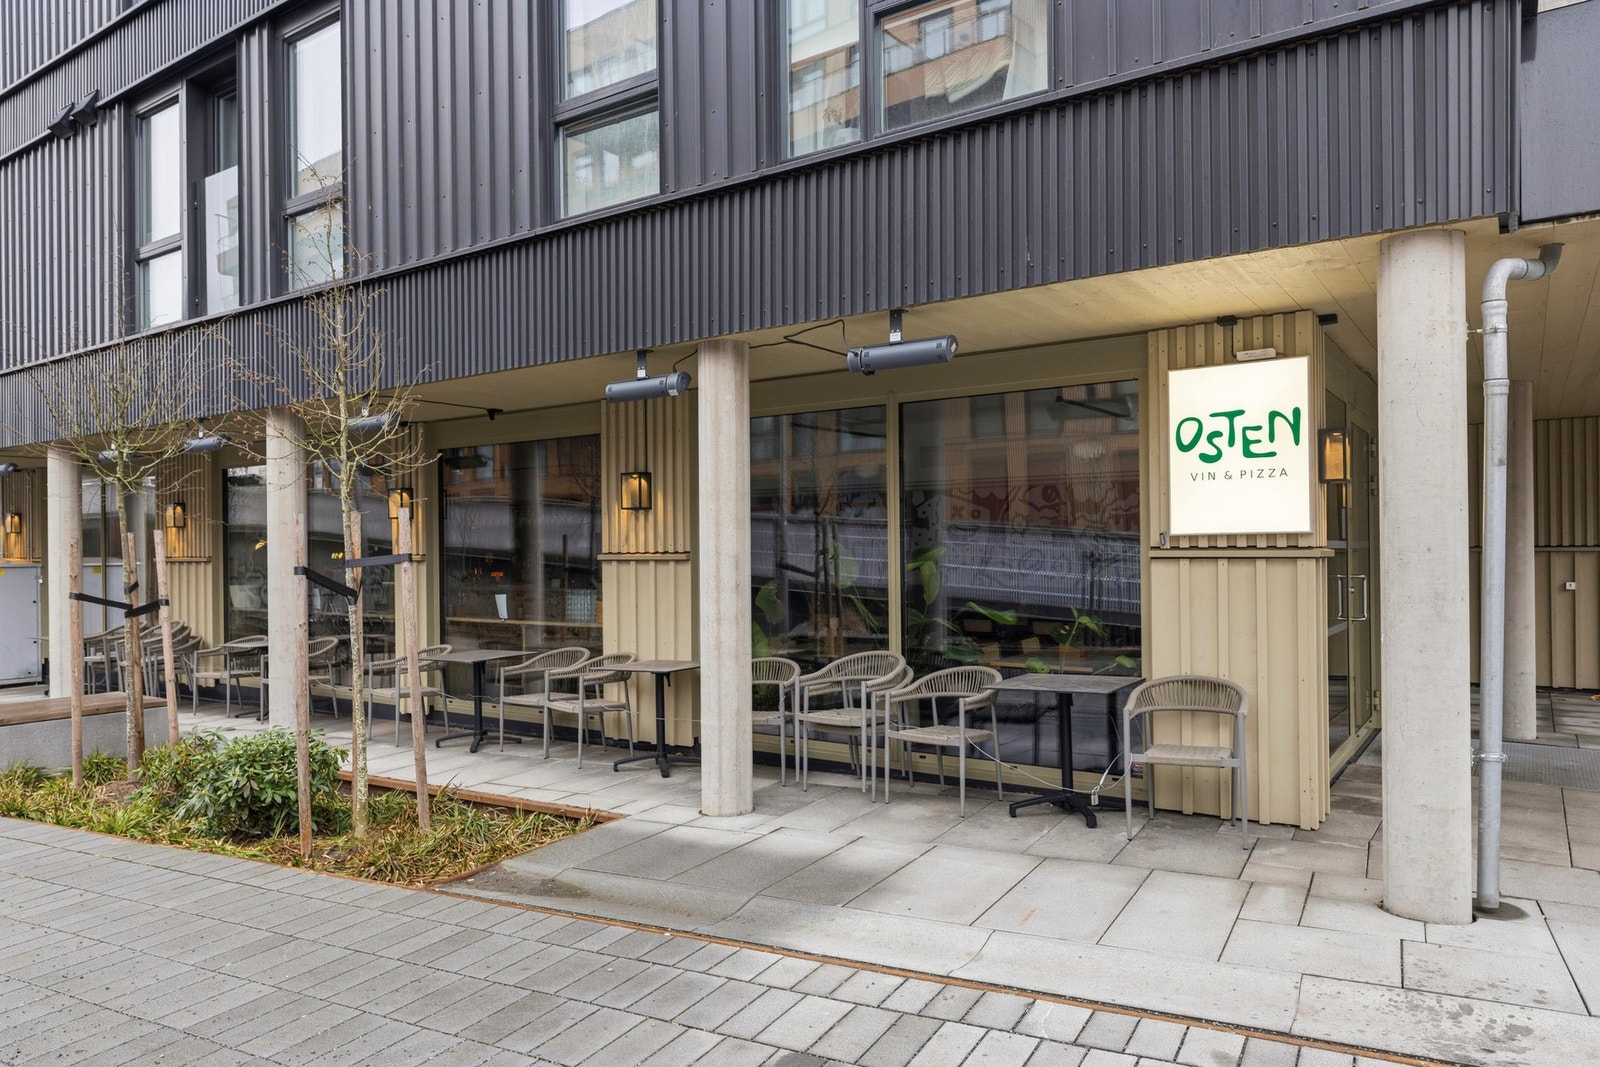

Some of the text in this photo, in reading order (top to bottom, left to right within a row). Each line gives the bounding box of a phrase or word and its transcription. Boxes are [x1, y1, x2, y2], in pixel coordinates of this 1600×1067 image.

[1175, 406, 1301, 464] OSTEN
[1190, 467, 1289, 482] VIN & PIZZA
